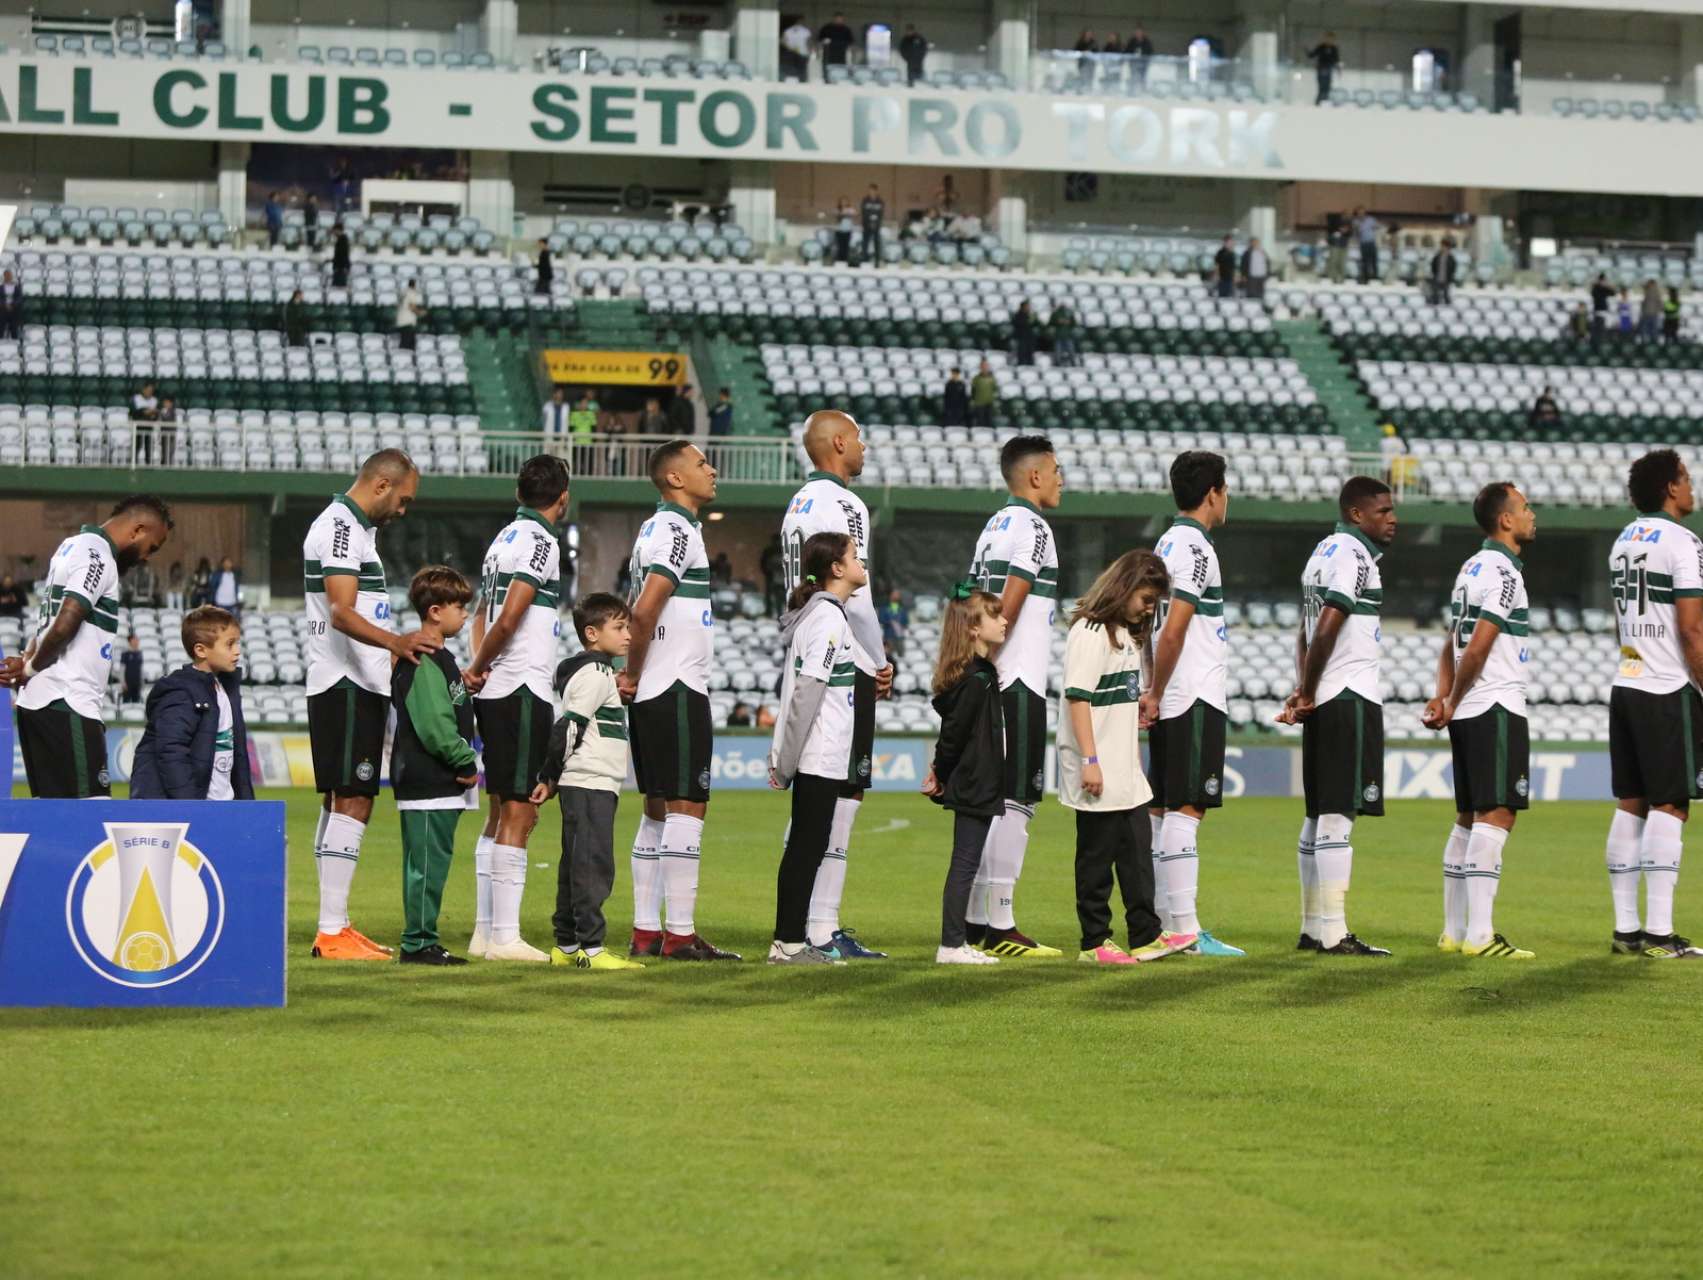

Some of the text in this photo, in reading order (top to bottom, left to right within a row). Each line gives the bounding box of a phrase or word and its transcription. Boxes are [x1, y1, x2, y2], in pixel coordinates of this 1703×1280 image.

[152, 69, 391, 135] CLUB
[530, 83, 820, 153] SETOR
[852, 96, 1023, 158] PRO
[1052, 101, 1286, 170] TORK
[648, 358, 679, 380] 99
[340, 524, 351, 560] TORK
[529, 543, 542, 570] PRO
[536, 540, 552, 574] TORK
[669, 534, 681, 565] PRO
[675, 531, 689, 569] TORK
[1632, 623, 1665, 639] LIMA
[161, 840, 170, 849] B
